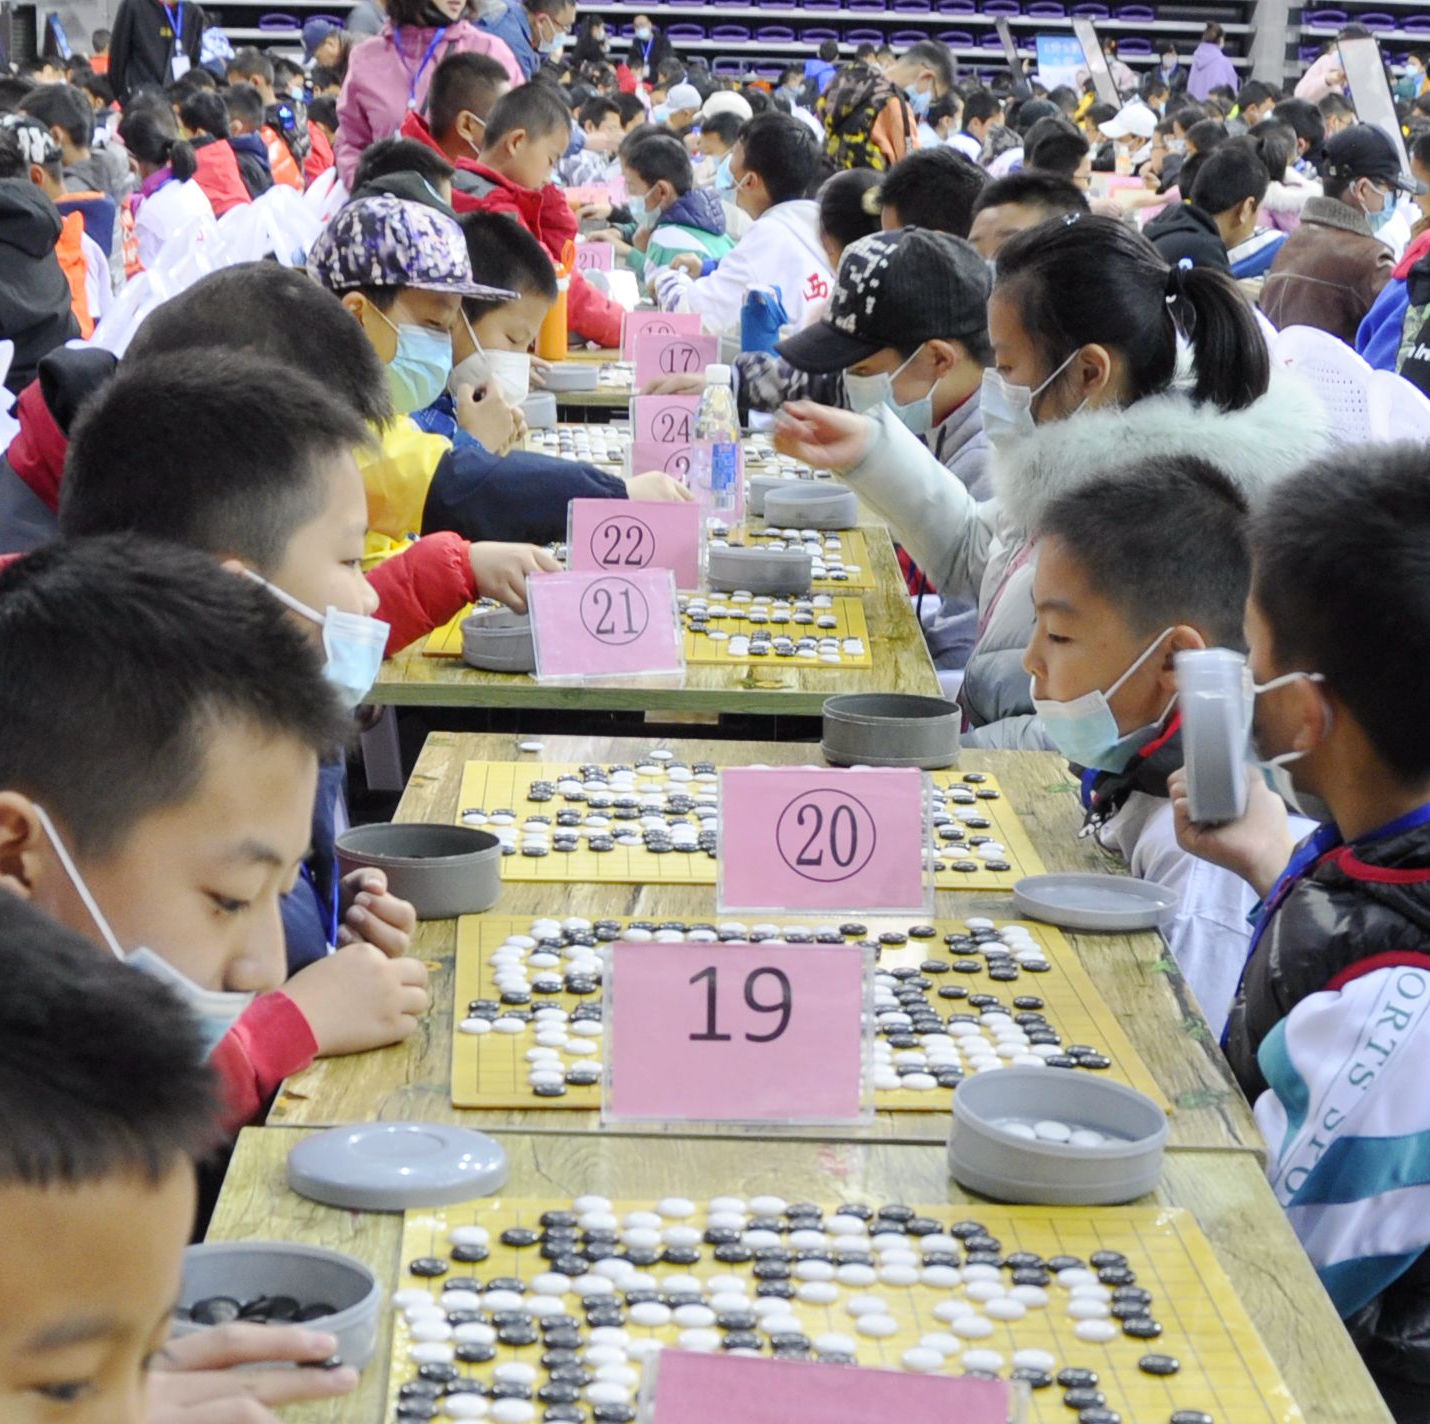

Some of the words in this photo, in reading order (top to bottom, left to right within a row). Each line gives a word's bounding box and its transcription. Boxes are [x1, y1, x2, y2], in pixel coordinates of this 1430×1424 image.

[602, 524, 644, 566] 22
[592, 587, 639, 635] 21
[796, 803, 858, 868] 20
[689, 966, 792, 1043] 19
